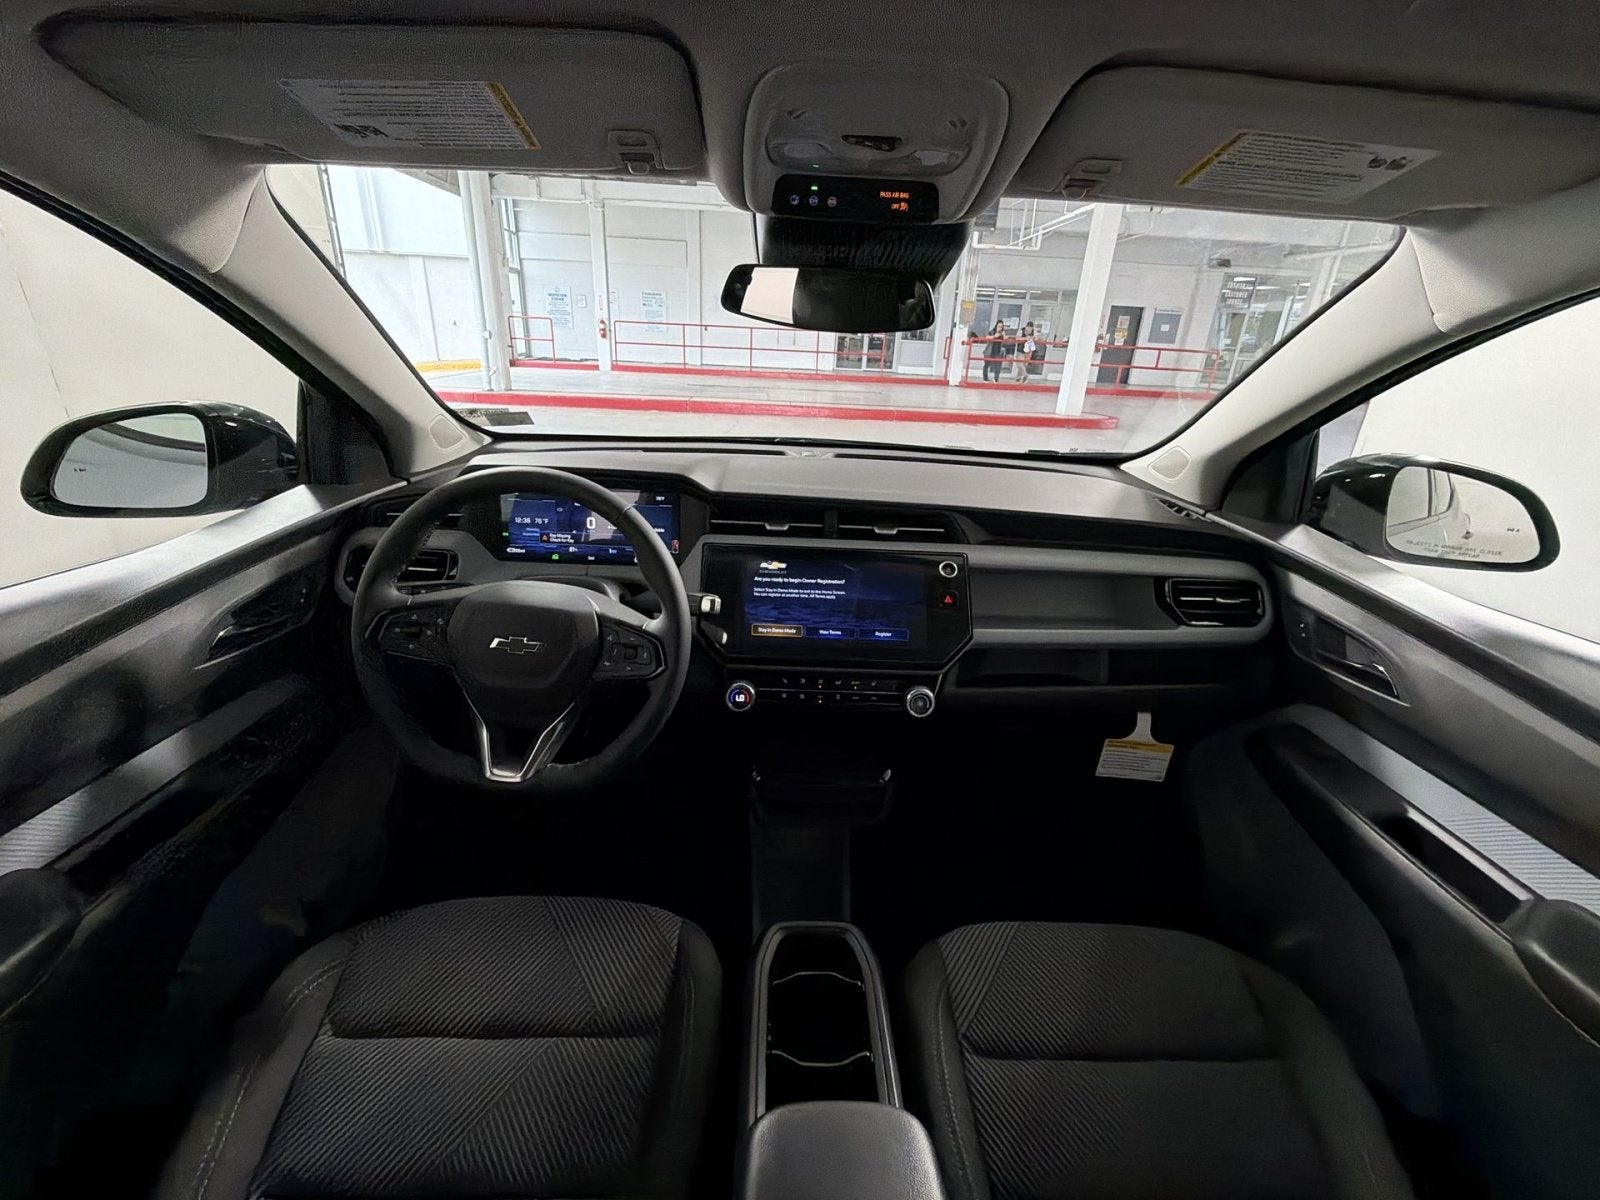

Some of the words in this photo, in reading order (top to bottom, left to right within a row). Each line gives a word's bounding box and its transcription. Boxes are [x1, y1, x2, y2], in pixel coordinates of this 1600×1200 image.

[892, 191, 900, 199] AIR
[586, 516, 596, 529] 0
[735, 694, 746, 702] LO
